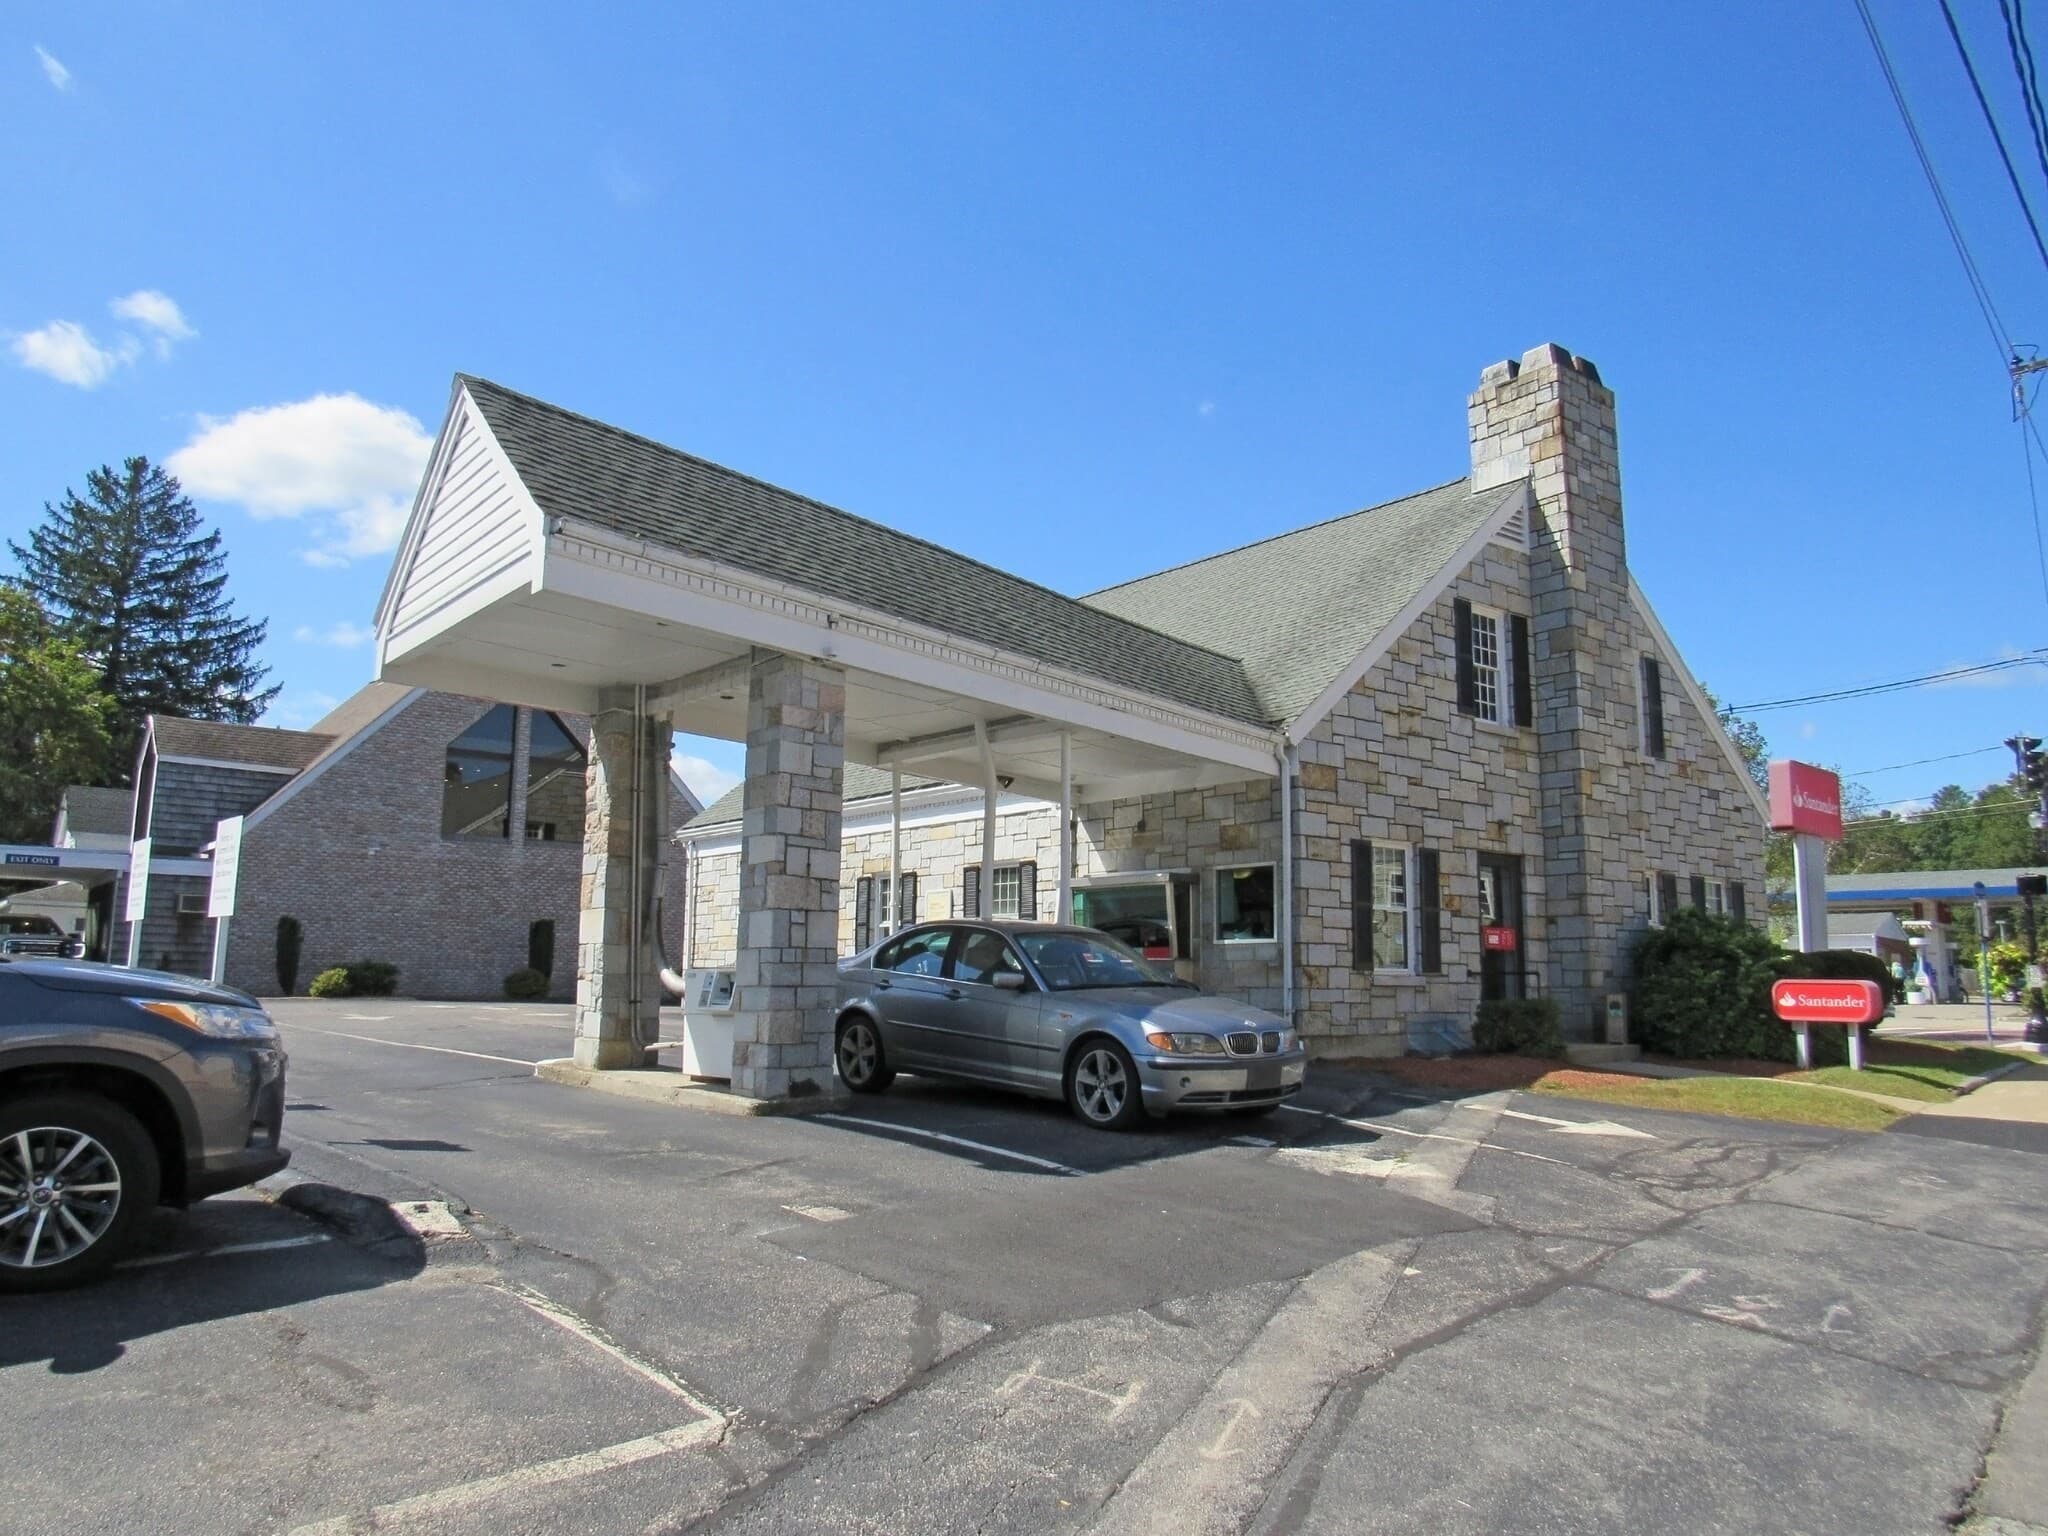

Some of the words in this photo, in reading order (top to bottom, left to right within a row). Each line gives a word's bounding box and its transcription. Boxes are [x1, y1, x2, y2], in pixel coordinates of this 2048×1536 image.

[1803, 791, 1838, 815] Santander
[10, 855, 29, 863] EXIT
[31, 857, 55, 865] ONLY
[1798, 993, 1865, 1008] Santander
